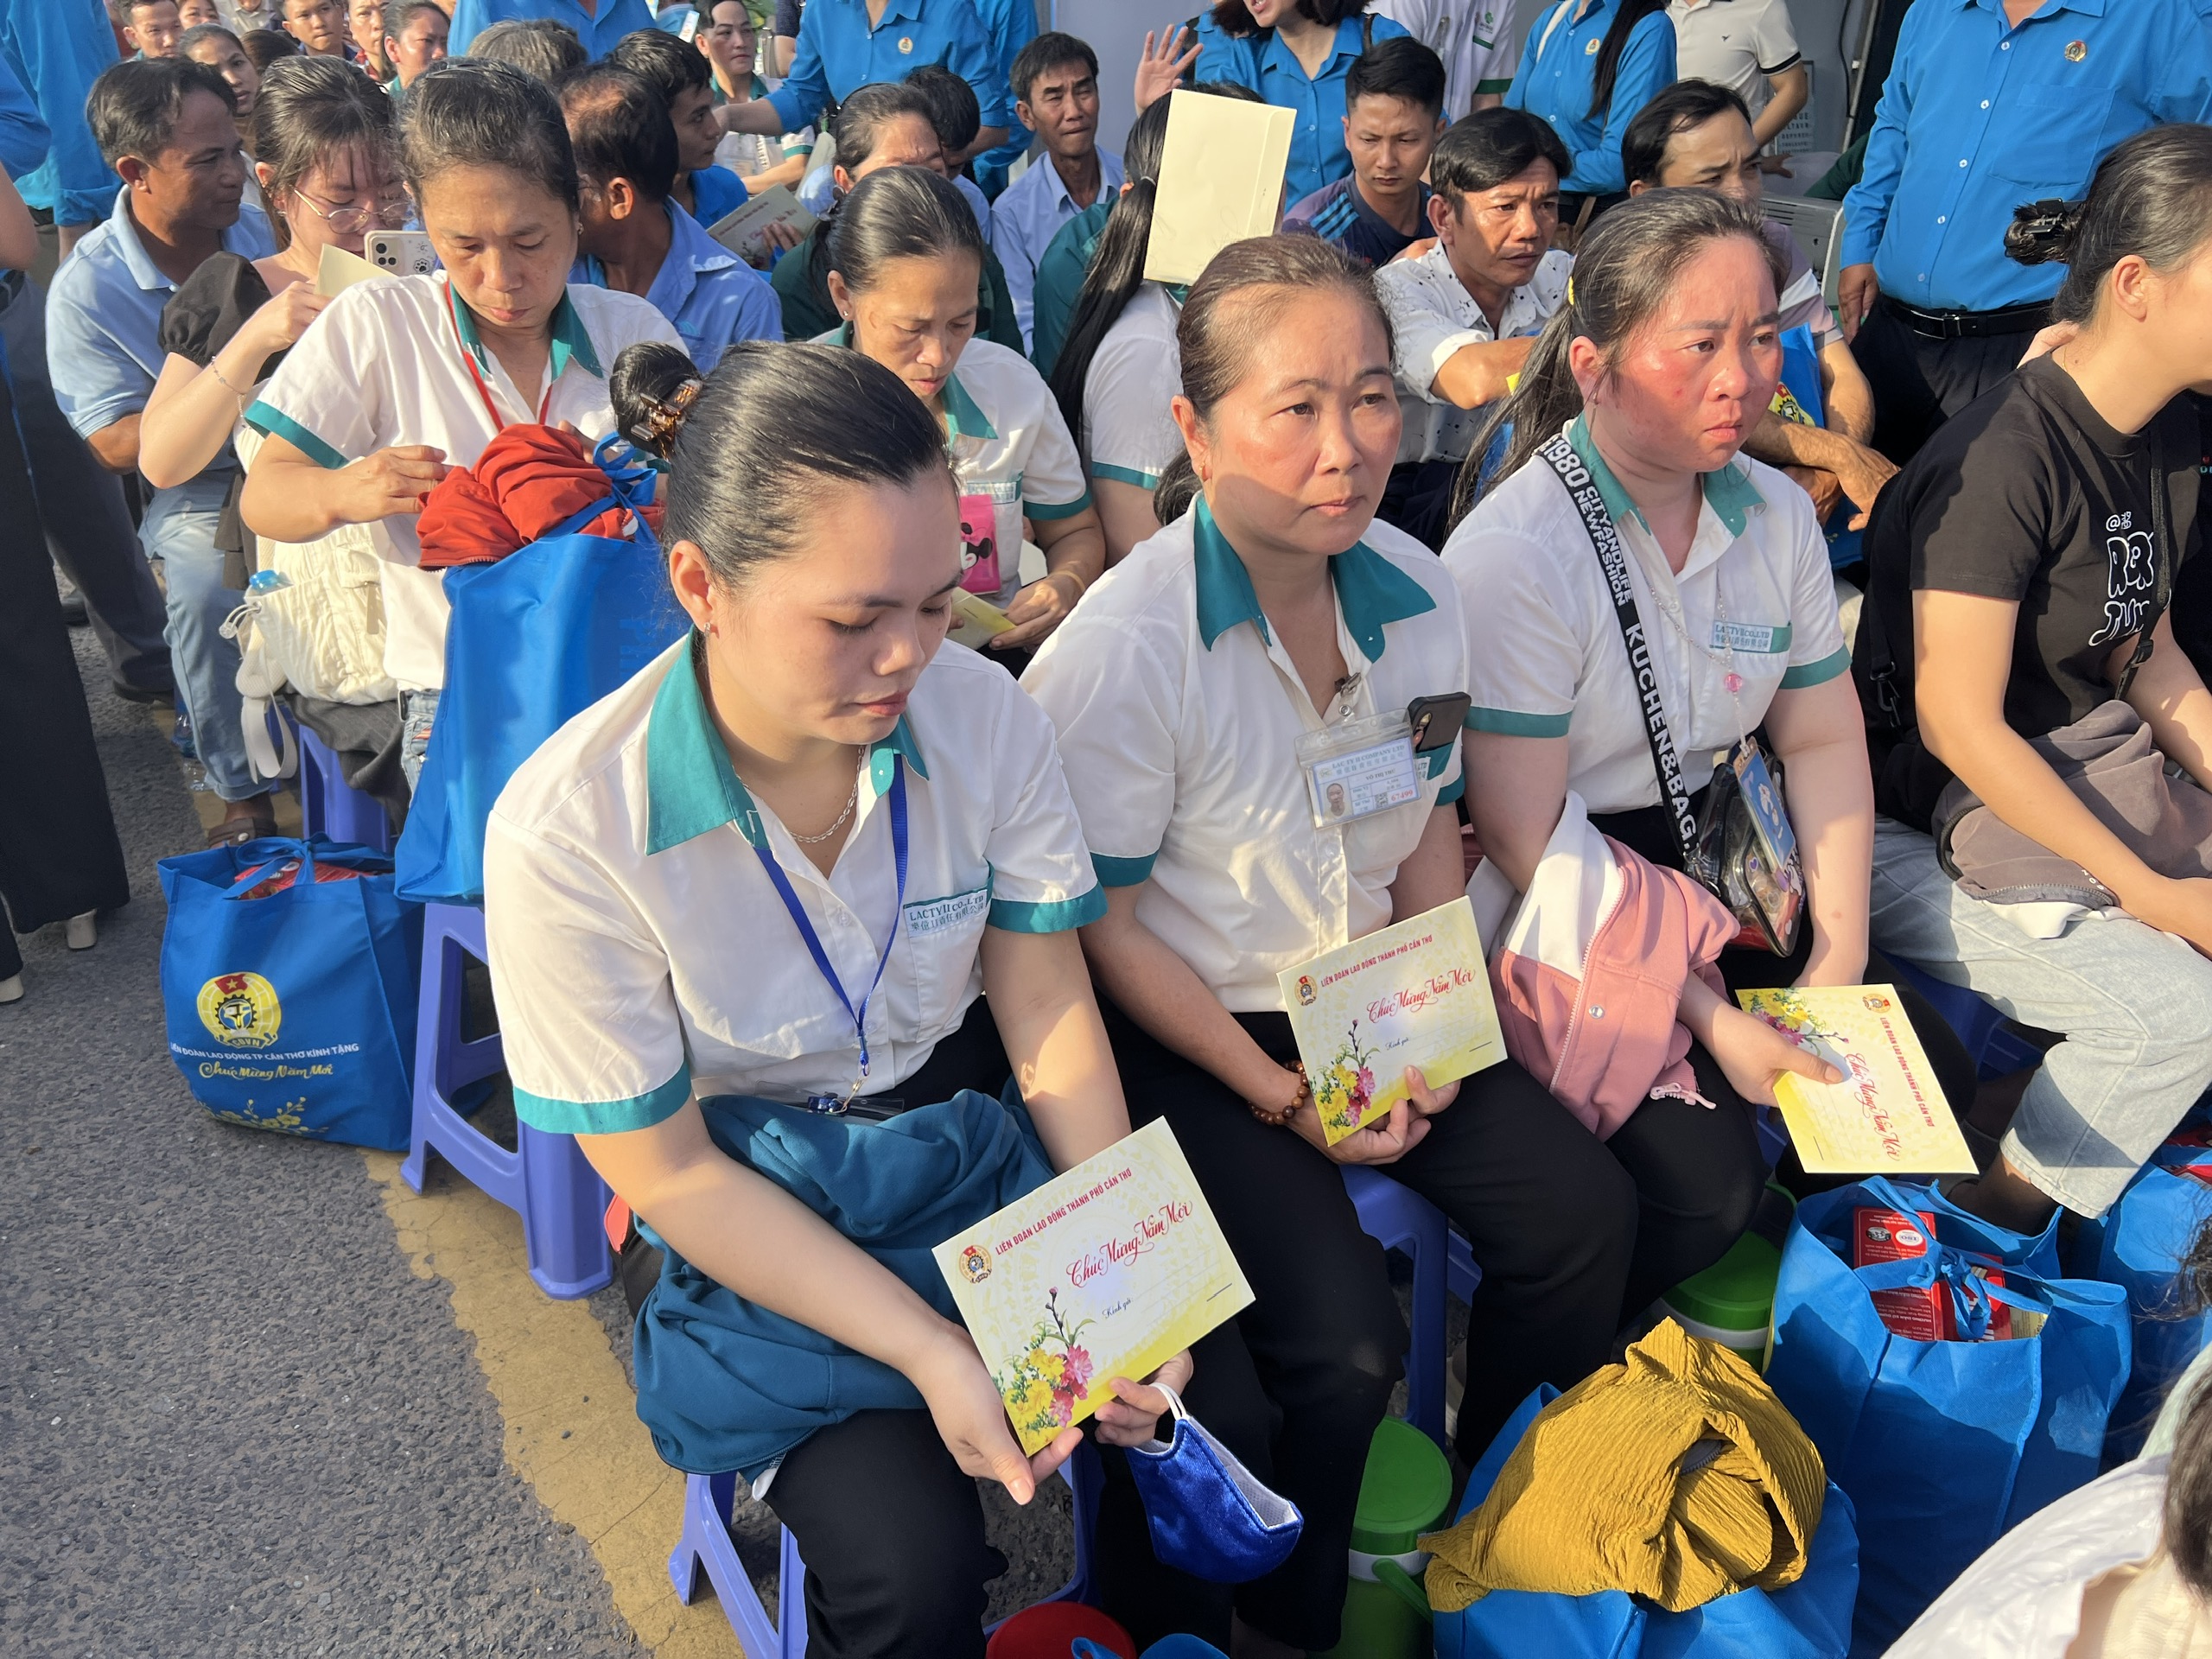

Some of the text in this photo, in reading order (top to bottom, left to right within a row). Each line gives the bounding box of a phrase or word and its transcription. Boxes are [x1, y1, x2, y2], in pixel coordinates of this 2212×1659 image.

[1543, 439, 1590, 488] 1980
[1391, 790, 1414, 801] 67499
[1321, 975, 1334, 988] LIÊN
[1350, 964, 1361, 975] LAO
[1377, 949, 1396, 963] THÀNH
[1396, 943, 1408, 955] PHỐ
[1422, 934, 1433, 944] THƠ
[1366, 996, 1396, 1024] Chúc
[1424, 974, 1452, 997] Năm
[1447, 967, 1476, 991] Mới
[285, 1051, 305, 1060] THƠ
[306, 1046, 331, 1058] KÍNH
[330, 1043, 359, 1056] TẶNG
[1892, 1045, 1902, 1056] LAO
[199, 1061, 238, 1078] Chúc
[1845, 1052, 1870, 1082] Chúc
[995, 1167, 1133, 1255] LIÊN ĐOÀN LAO ĐỘNG THÀNH PHỐ CẦN THƠ
[1065, 1199, 1193, 1288] Chúc Mừng Năm Mới
[1102, 1302, 1122, 1319] Kính
